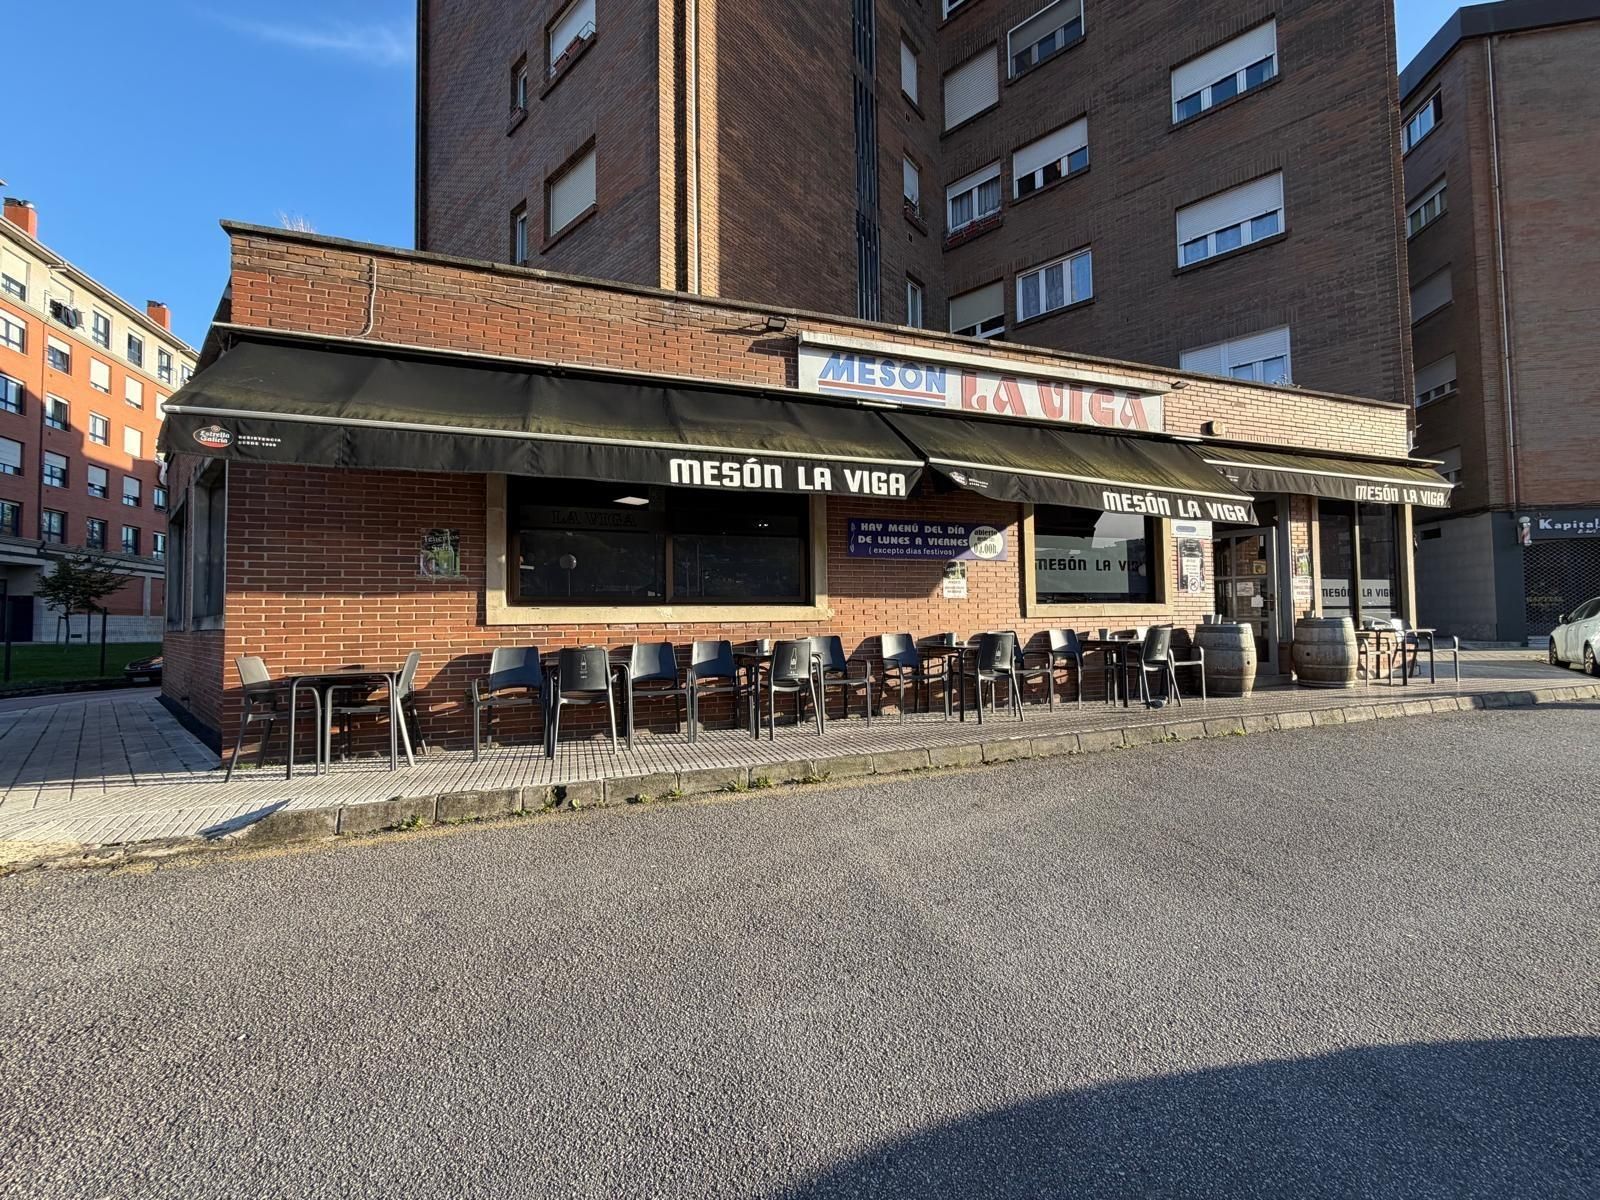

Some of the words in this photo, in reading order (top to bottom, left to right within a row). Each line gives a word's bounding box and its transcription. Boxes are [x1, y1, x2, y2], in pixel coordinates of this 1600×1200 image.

[960, 369, 1028, 417] LA
[1036, 380, 1150, 430] VIGA
[669, 457, 783, 489] MESÓN
[798, 466, 832, 491] LA
[844, 469, 906, 497] VIGA
[1355, 484, 1399, 502] MESÓN
[1403, 488, 1418, 503] LA
[1420, 491, 1445, 506] VIGA
[1102, 491, 1171, 516] MESÓN
[1178, 499, 1201, 518] LA
[1205, 503, 1249, 522] VIGA
[861, 523, 883, 532] HAY
[888, 523, 919, 533] MENÚ
[924, 526, 943, 534] DEL
[947, 524, 965, 534] DÍA
[858, 535, 872, 544] DE
[877, 536, 910, 545] LUNES
[927, 538, 969, 547] VIERNES
[1095, 560, 1111, 571] LA
[1362, 588, 1373, 598] LA
